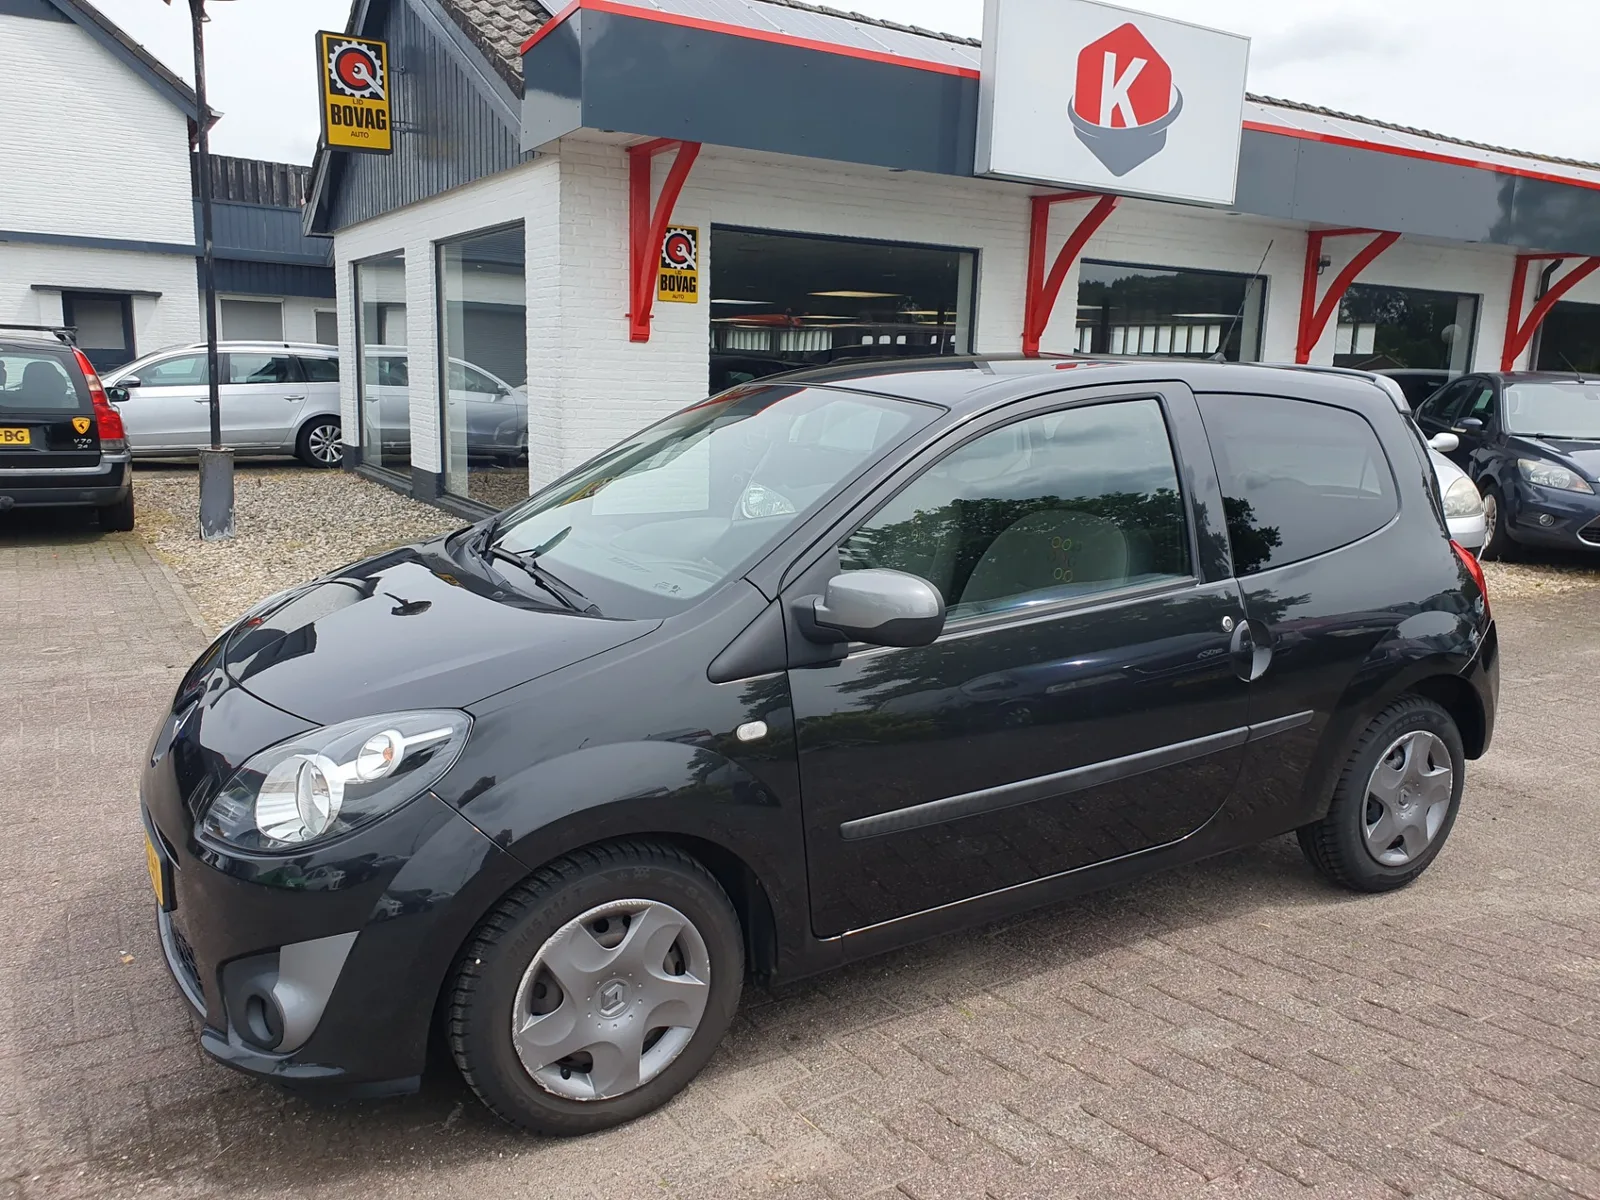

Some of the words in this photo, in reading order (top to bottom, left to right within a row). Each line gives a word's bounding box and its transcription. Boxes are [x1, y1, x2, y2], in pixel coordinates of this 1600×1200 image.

[1099, 51, 1148, 128] K
[330, 103, 387, 130] BOVAG
[350, 130, 370, 139] AUTO
[660, 274, 697, 293] BOVAG
